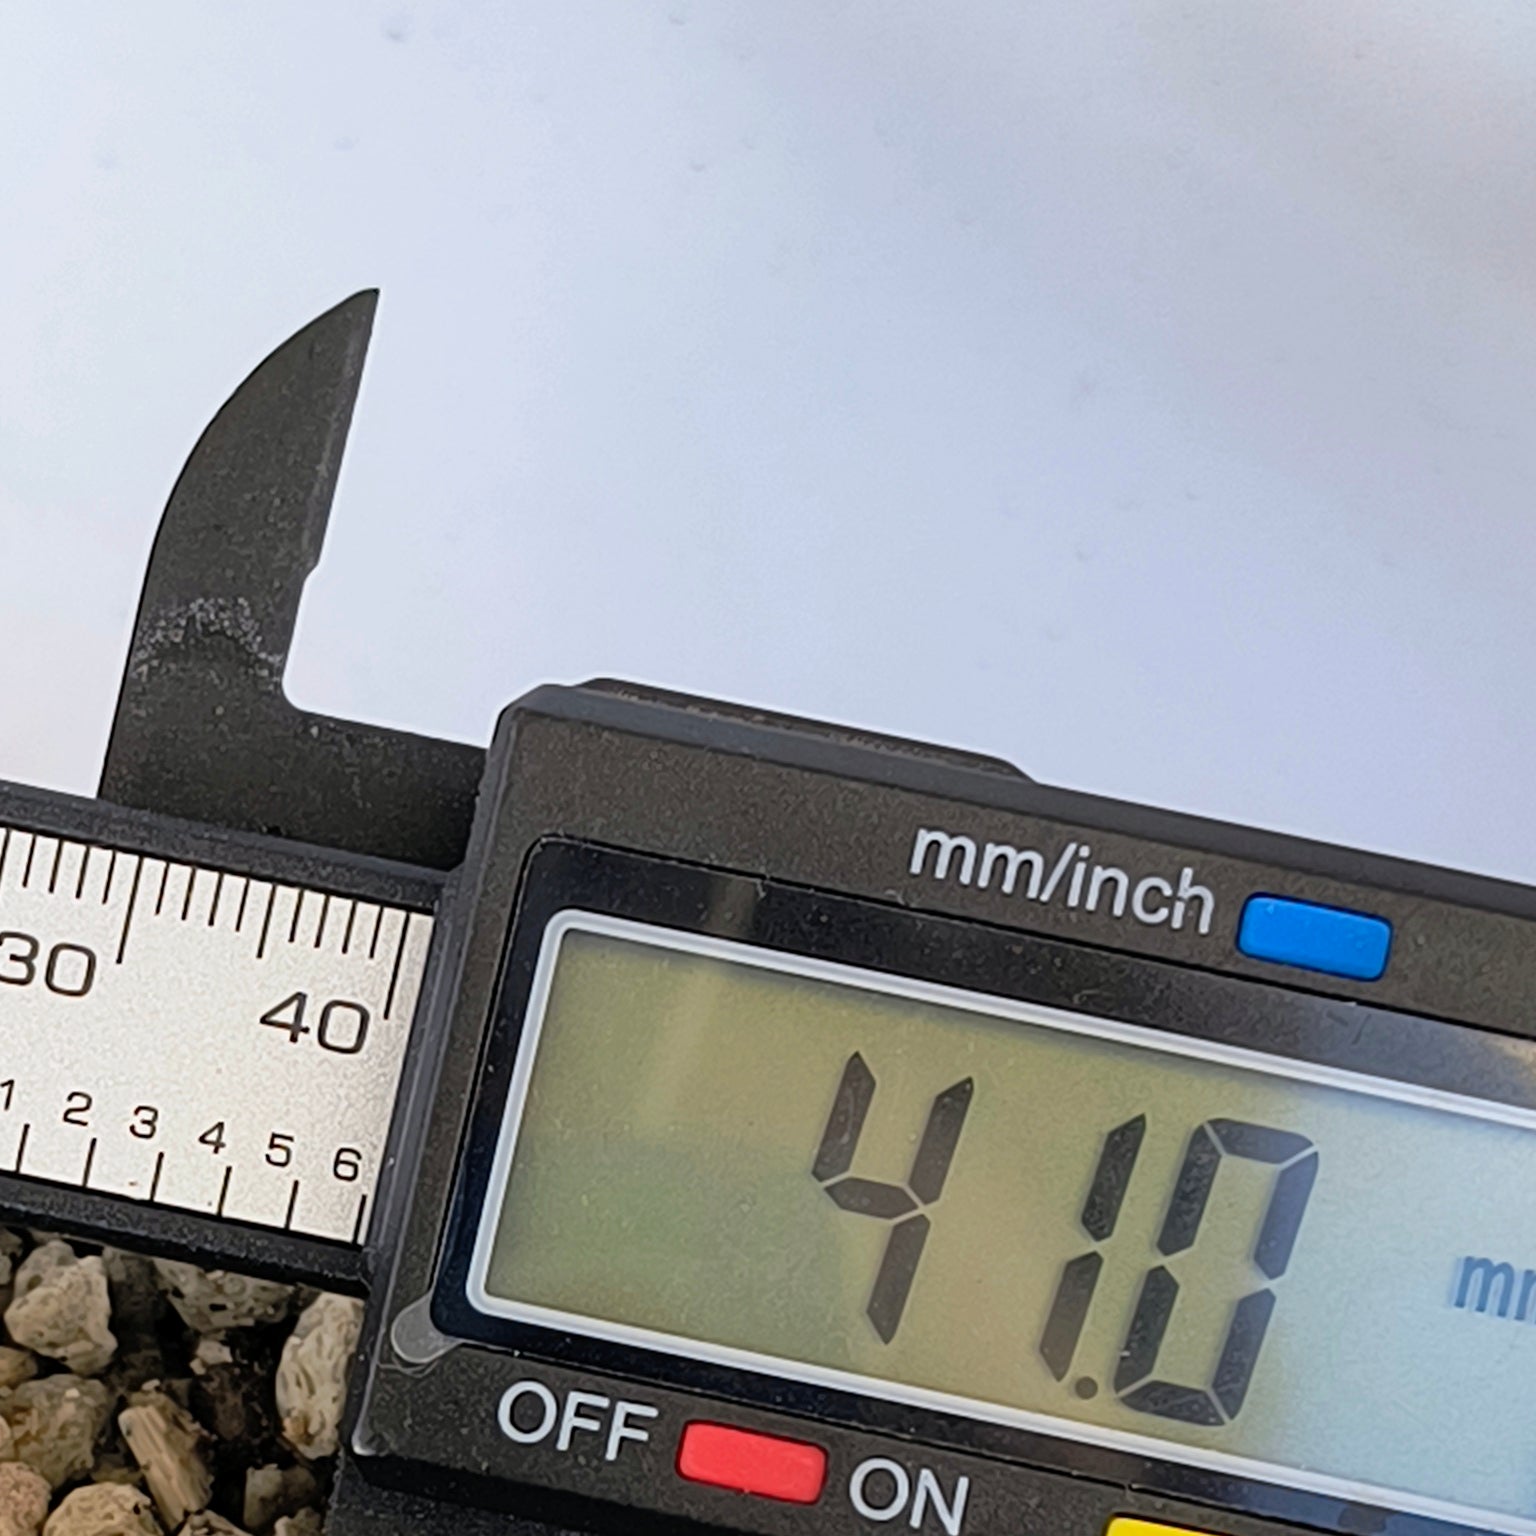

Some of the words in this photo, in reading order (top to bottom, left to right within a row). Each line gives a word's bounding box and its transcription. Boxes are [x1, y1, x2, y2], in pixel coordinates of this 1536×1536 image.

[911, 829, 1213, 933] mm/inch
[260, 992, 370, 1054] 40
[0, 1079, 14, 1110] 1
[63, 1092, 92, 1126] 2
[130, 1106, 158, 1139] 3
[198, 1122, 225, 1154] 4
[265, 1132, 294, 1167] 5
[333, 1148, 362, 1182] 6
[811, 1048, 1322, 1427] 41.0
[499, 1382, 658, 1460] OFF
[850, 1459, 968, 1536] ON
